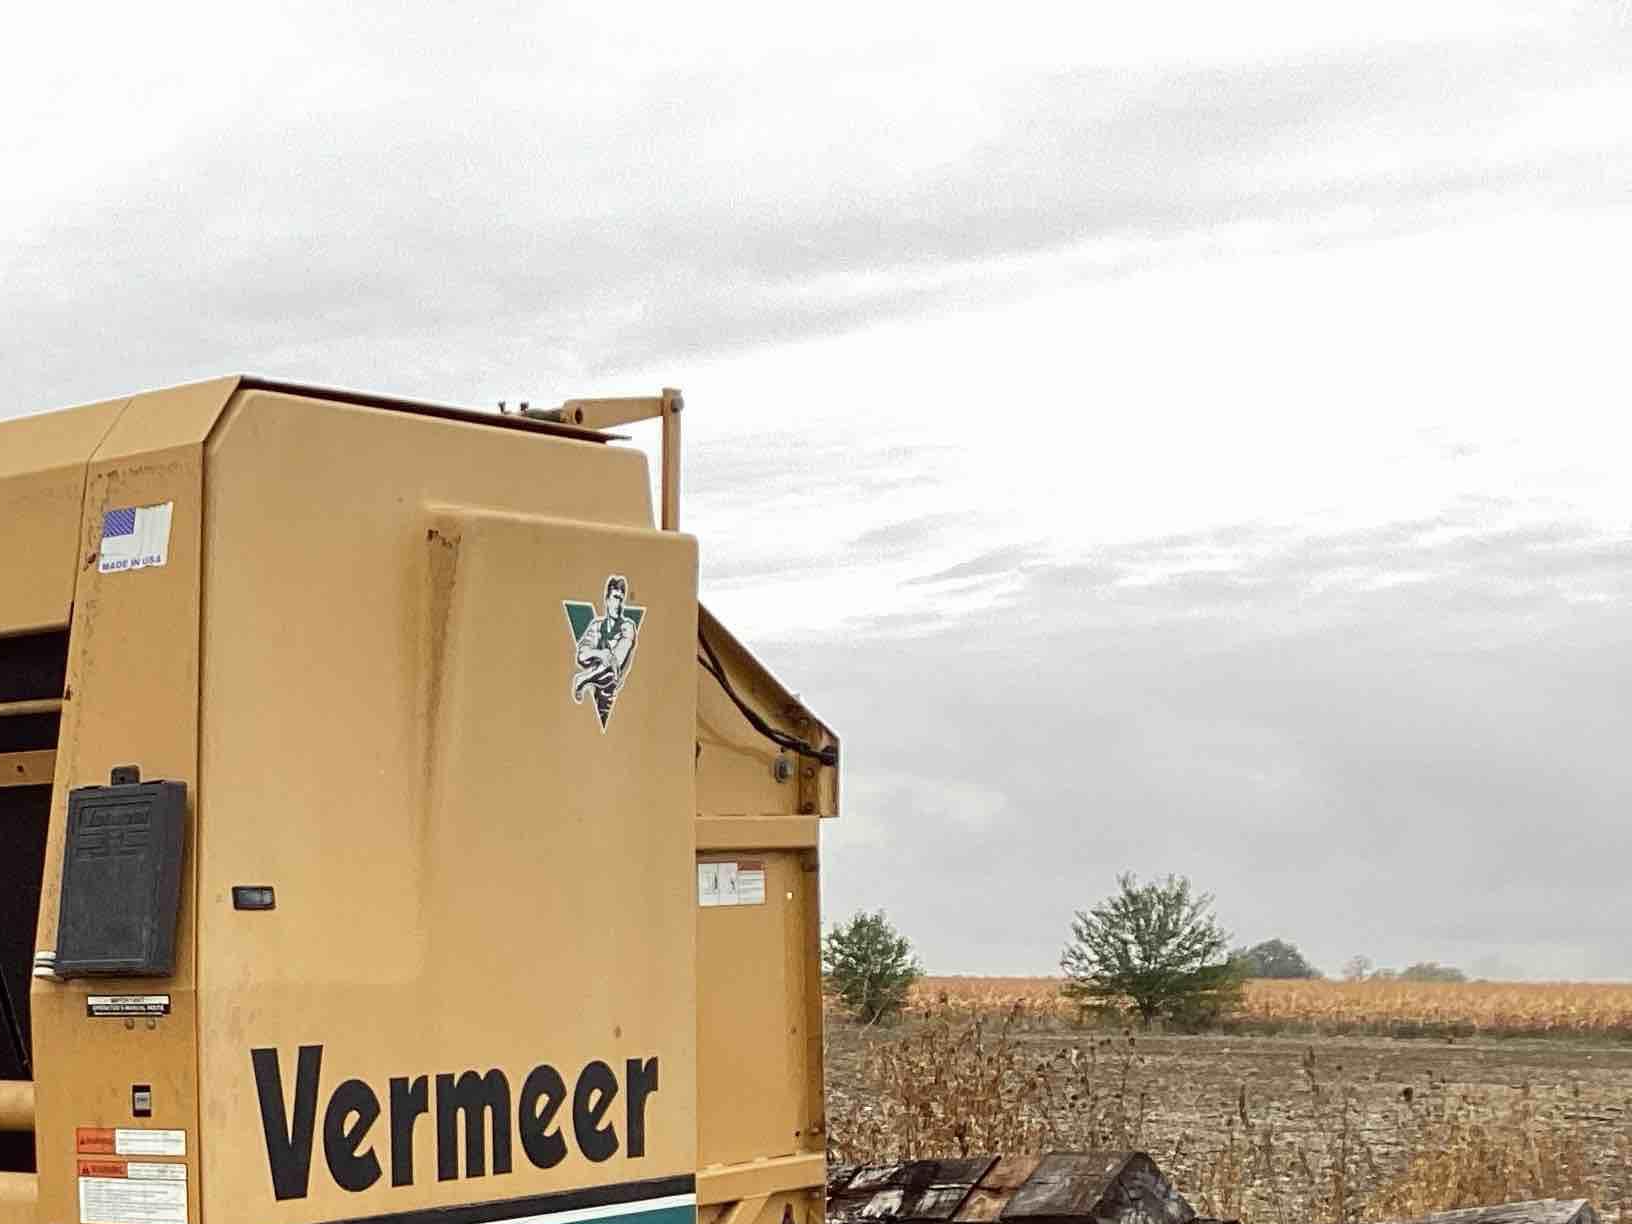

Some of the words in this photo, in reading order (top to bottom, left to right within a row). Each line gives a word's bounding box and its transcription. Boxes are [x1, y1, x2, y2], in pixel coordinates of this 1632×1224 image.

[102, 559, 129, 571] MADE
[130, 558, 141, 567] IN
[250, 1044, 659, 1201] Vermeer
